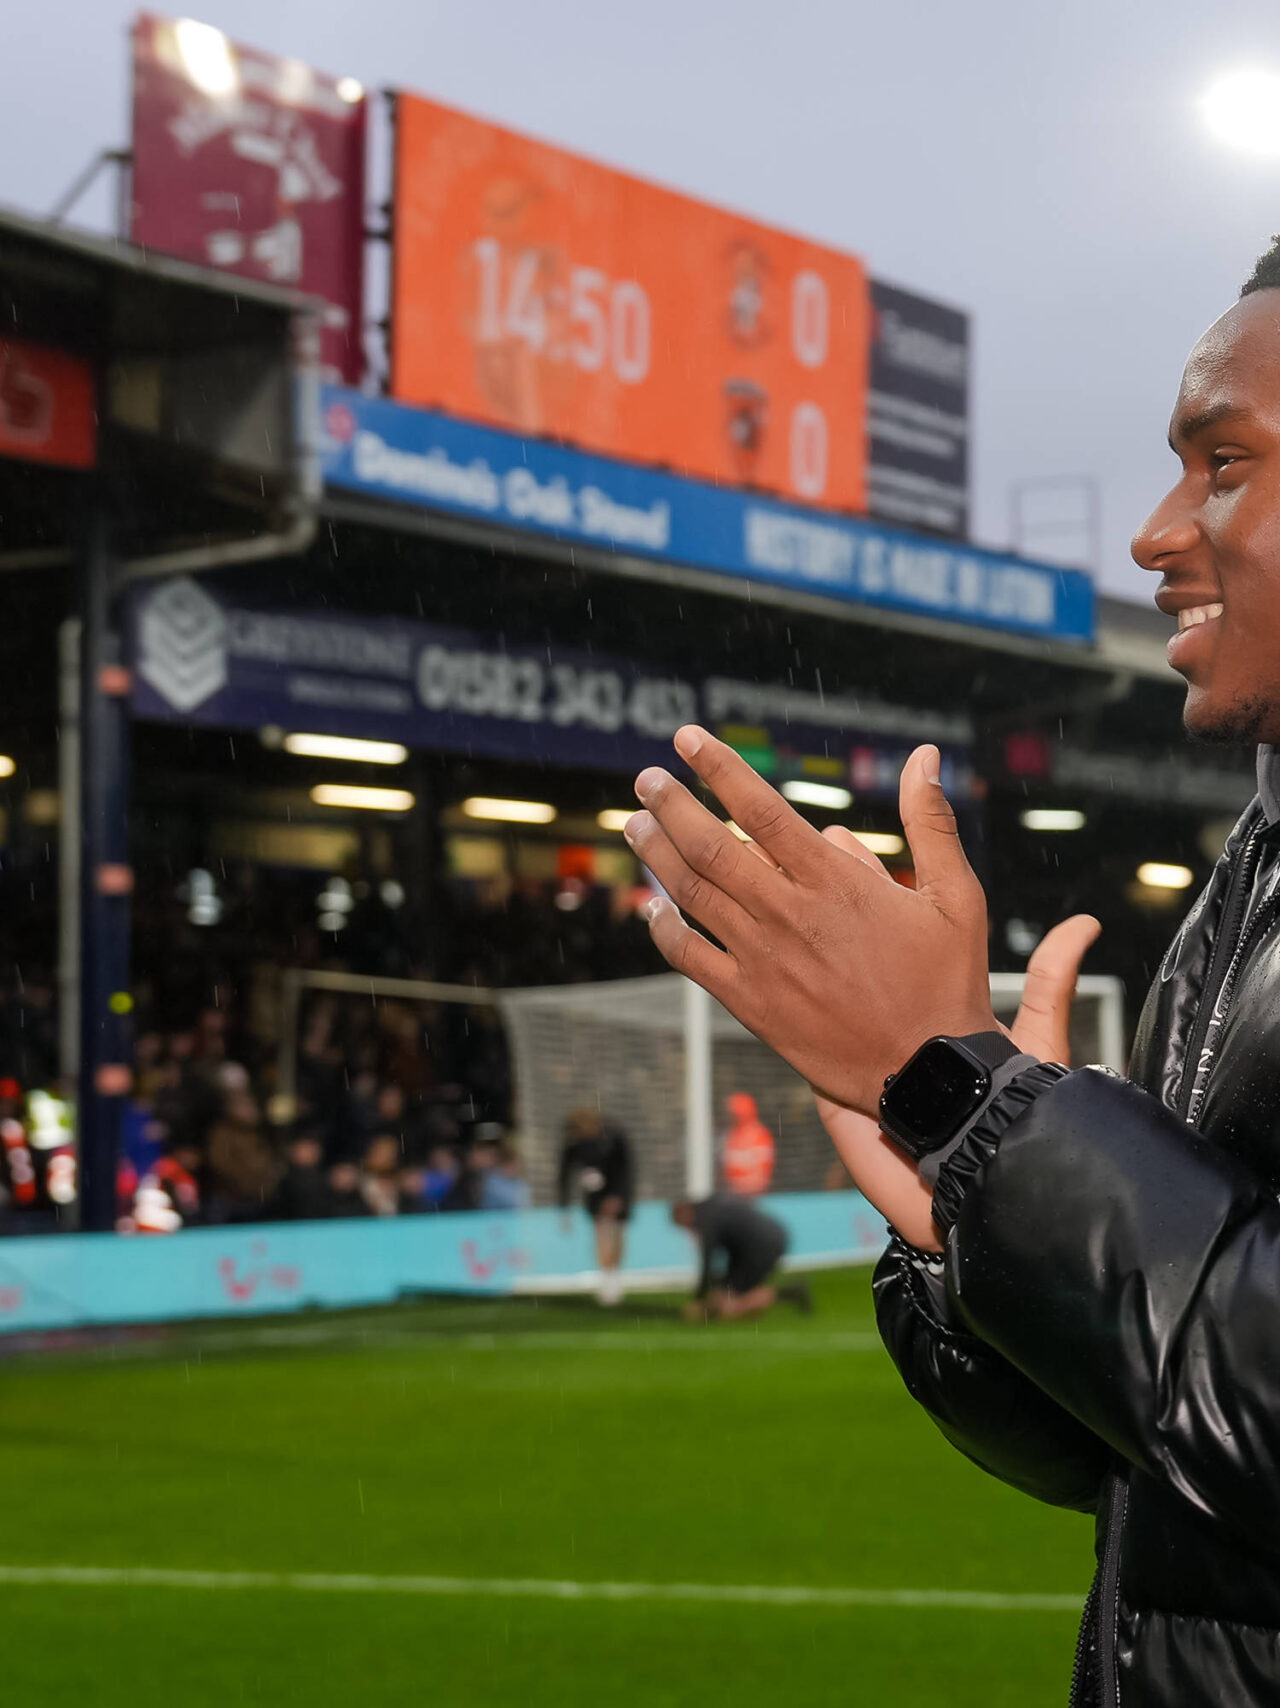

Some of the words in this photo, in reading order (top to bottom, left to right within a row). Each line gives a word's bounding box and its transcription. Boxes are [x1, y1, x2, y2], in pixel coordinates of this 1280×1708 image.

[474, 237, 651, 384] 14:50
[791, 268, 829, 370] 0
[790, 401, 828, 500] 0
[505, 467, 575, 529] Oak
[579, 486, 671, 550] Stand
[417, 643, 544, 723] 01582
